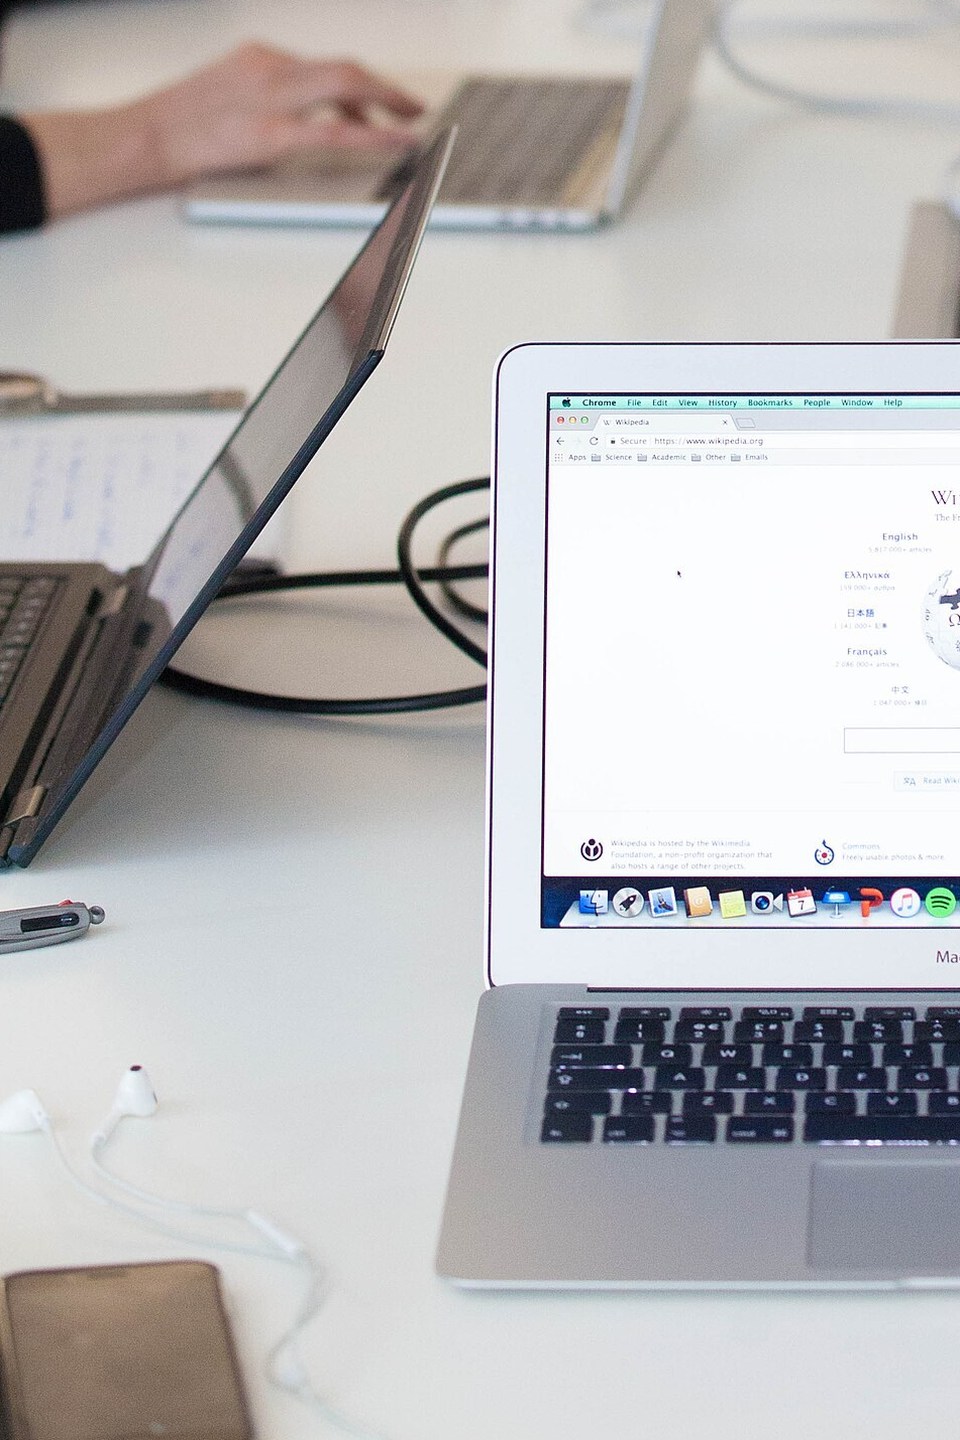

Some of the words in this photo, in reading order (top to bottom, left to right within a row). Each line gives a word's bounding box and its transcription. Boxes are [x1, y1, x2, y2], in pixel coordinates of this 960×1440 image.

[709, 399, 737, 408] History
[804, 399, 830, 408] People
[884, 399, 902, 408] Help
[620, 437, 647, 445] Secure
[654, 436, 764, 447] https://www.wikipedia.org
[568, 454, 586, 462] Apps
[935, 513, 949, 521] The
[882, 532, 918, 542] English
[844, 571, 890, 580] Ελληνικά
[847, 608, 874, 617] 日本語
[847, 647, 888, 657] Français
[891, 686, 909, 694] 中文
[611, 840, 647, 848] Wikipedia
[686, 840, 694, 848] by
[842, 842, 880, 850] Commons
[665, 851, 705, 859] non-profit
[707, 851, 755, 859] organization
[798, 900, 805, 911] 7
